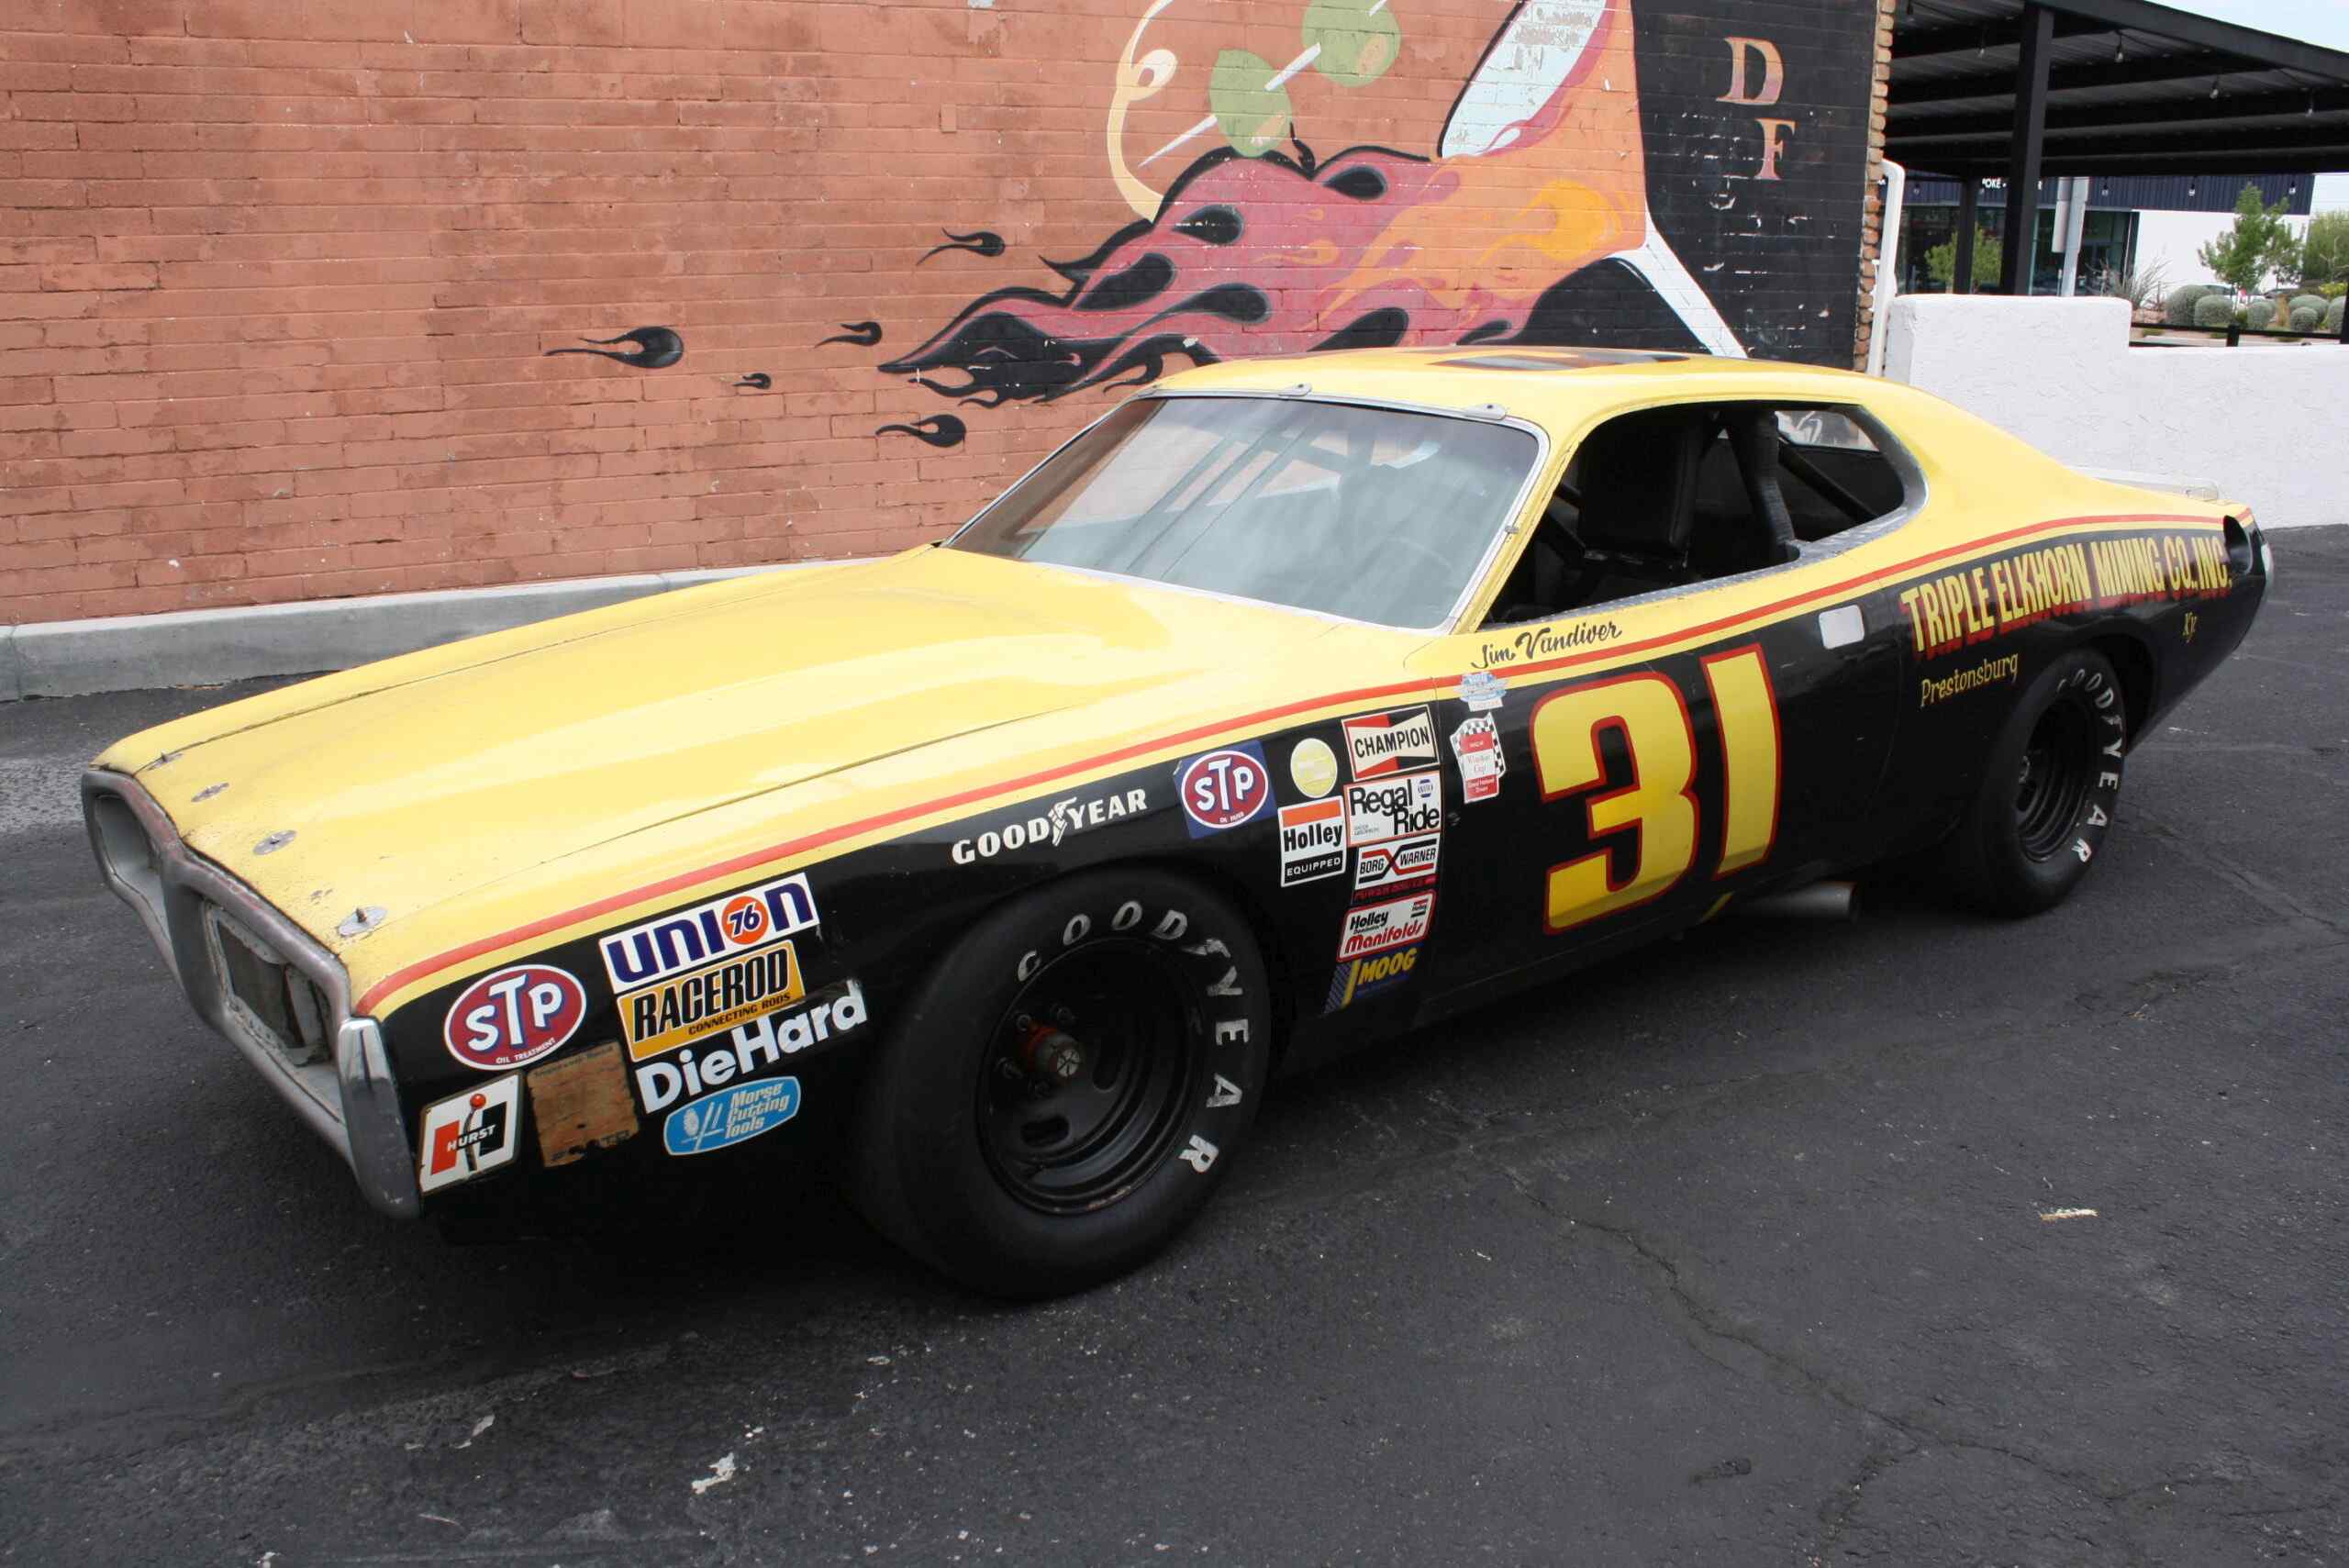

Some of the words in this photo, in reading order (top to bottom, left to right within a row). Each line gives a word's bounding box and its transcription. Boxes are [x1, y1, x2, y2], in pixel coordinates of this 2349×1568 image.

[1715, 37, 1784, 106] D
[1753, 118, 1797, 181] F
[1900, 567, 1996, 652] TRIPLE
[1990, 543, 2092, 623] ELKHORN
[2090, 537, 2165, 597] MINING
[1471, 644, 1516, 669] Jim
[1514, 620, 1622, 660] Vandiver
[1920, 652, 2019, 709] Prestonsburg
[1354, 726, 1431, 759] CHAMPION
[1195, 758, 1254, 811] STP
[1349, 779, 1413, 817] Regal
[1530, 642, 1782, 936] 31
[952, 788, 1148, 865] GOODYEAR
[1284, 823, 1343, 852] Holley
[1394, 803, 1440, 836] Ride
[1286, 857, 1341, 877] EQUIPPED
[1359, 858, 1385, 875] BORG
[1399, 847, 1437, 866] WARNER
[729, 902, 763, 939] 76
[1344, 919, 1423, 954] Manifolds
[1350, 910, 1389, 930] Holley
[1358, 947, 1418, 985] MOOG
[465, 973, 562, 1051] STP
[633, 947, 789, 1043] RACEROD
[688, 1004, 758, 1036] CONNECTING
[762, 992, 791, 1010] RODS
[495, 1056, 510, 1064] OIL
[514, 1037, 556, 1062] TREATMENT
[634, 979, 868, 1115] DieHard
[1018, 900, 1251, 1173] GOODYEAR
[728, 1093, 791, 1121] Cutting
[731, 1081, 785, 1108] Morse
[446, 1123, 497, 1153] HURST
[725, 1115, 765, 1140] Tools
